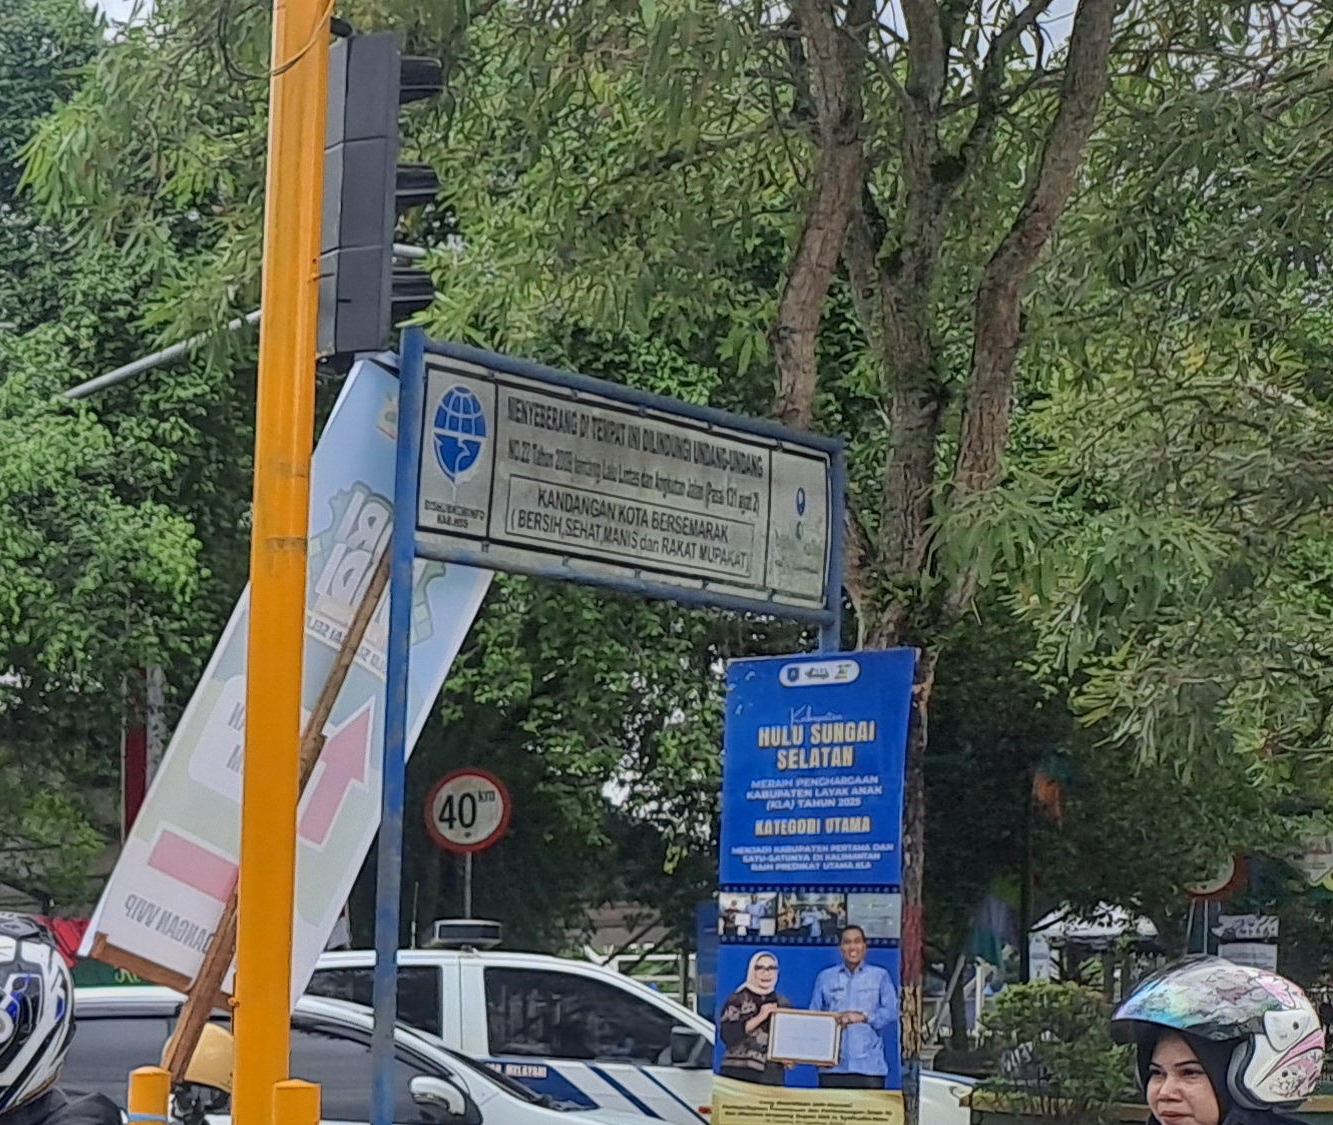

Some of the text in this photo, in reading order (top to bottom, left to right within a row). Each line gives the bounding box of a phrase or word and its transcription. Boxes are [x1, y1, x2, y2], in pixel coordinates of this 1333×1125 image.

[536, 484, 729, 544] KANDANGAN KOTA BERSEMARAK
[639, 534, 660, 553] dan
[661, 536, 697, 560] RAKAT
[757, 719, 876, 748] HULU SUNGAI
[776, 744, 854, 771] SELATAN
[745, 784, 884, 801] KABUPATEN LAYAK ANAK
[795, 774, 880, 788] PENGHARGAAN
[438, 789, 496, 829] 40 km
[766, 799, 795, 812] (KLA)
[797, 797, 836, 809] TAHUN
[754, 815, 872, 837] KATEGORI UTAMA
